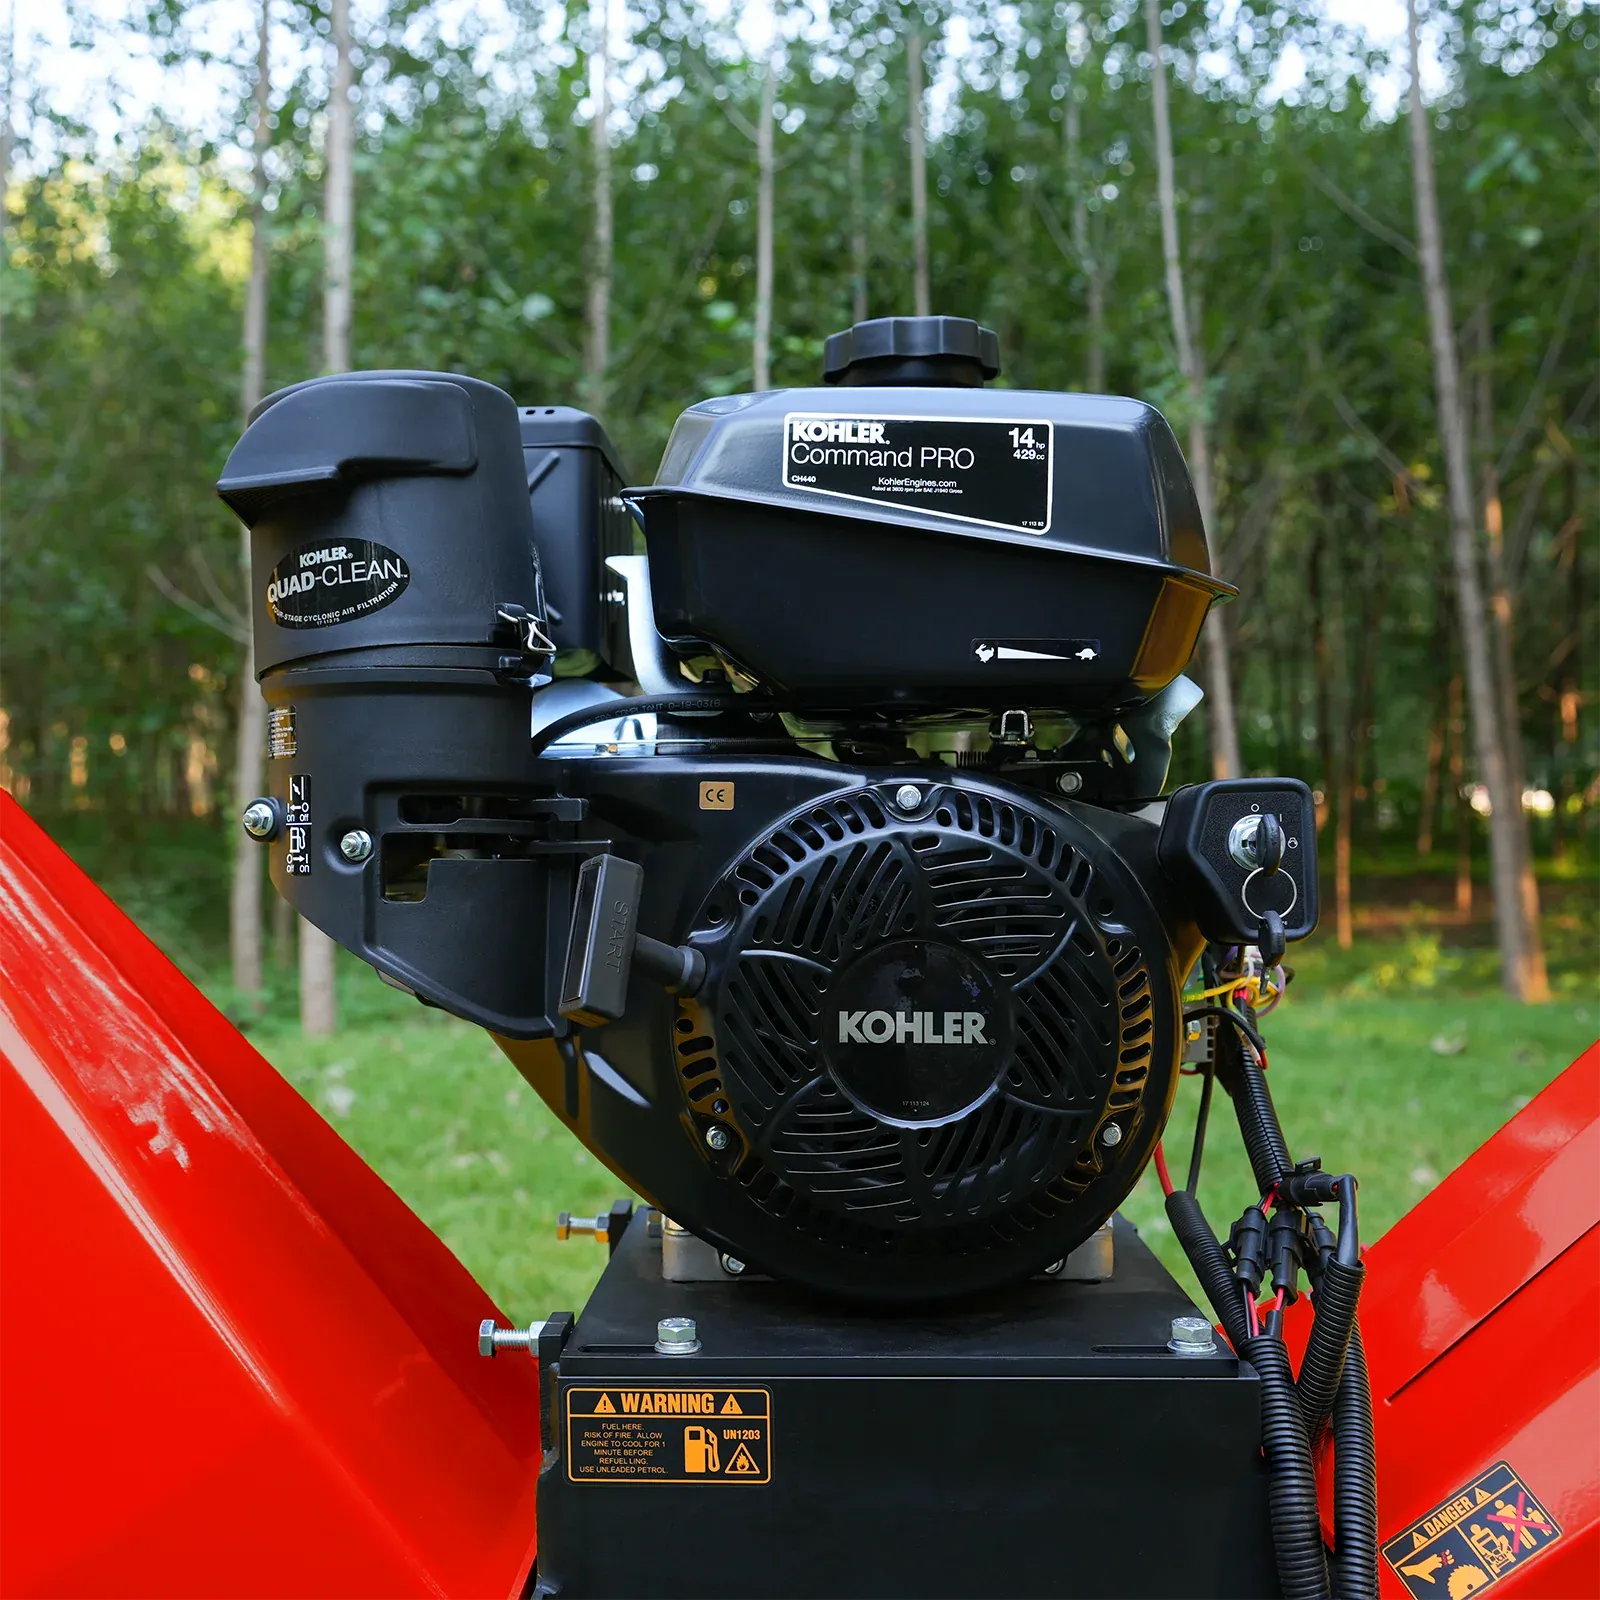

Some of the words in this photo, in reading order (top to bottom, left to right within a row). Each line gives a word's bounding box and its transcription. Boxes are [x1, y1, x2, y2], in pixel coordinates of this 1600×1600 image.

[792, 420, 887, 444] KOHLER
[791, 442, 912, 468] Command
[920, 447, 975, 470] PRO
[791, 475, 817, 483] CH440
[878, 477, 957, 488] KohlerEngines.com
[299, 546, 348, 568] KOHLER
[303, 610, 341, 622] CYCLONIC
[341, 606, 356, 616] AIR
[356, 581, 399, 611] FILTRATION
[605, 899, 630, 974] START
[838, 1010, 989, 1044] KOHLER
[620, 1392, 715, 1414] WARNING
[622, 1423, 645, 1431] HERE.
[584, 1431, 602, 1439] RISK
[602, 1431, 613, 1439] OF
[614, 1431, 634, 1439] FIRE.
[723, 1429, 761, 1441] UN1203
[621, 1440, 643, 1448] COOL
[644, 1440, 660, 1448] FOR
[623, 1449, 654, 1457] BEFORE
[599, 1457, 628, 1465] REFUEL
[596, 1466, 636, 1474] UNLEADED
[637, 1466, 669, 1474] PETROL.
[1422, 1496, 1475, 1538] DANGER
